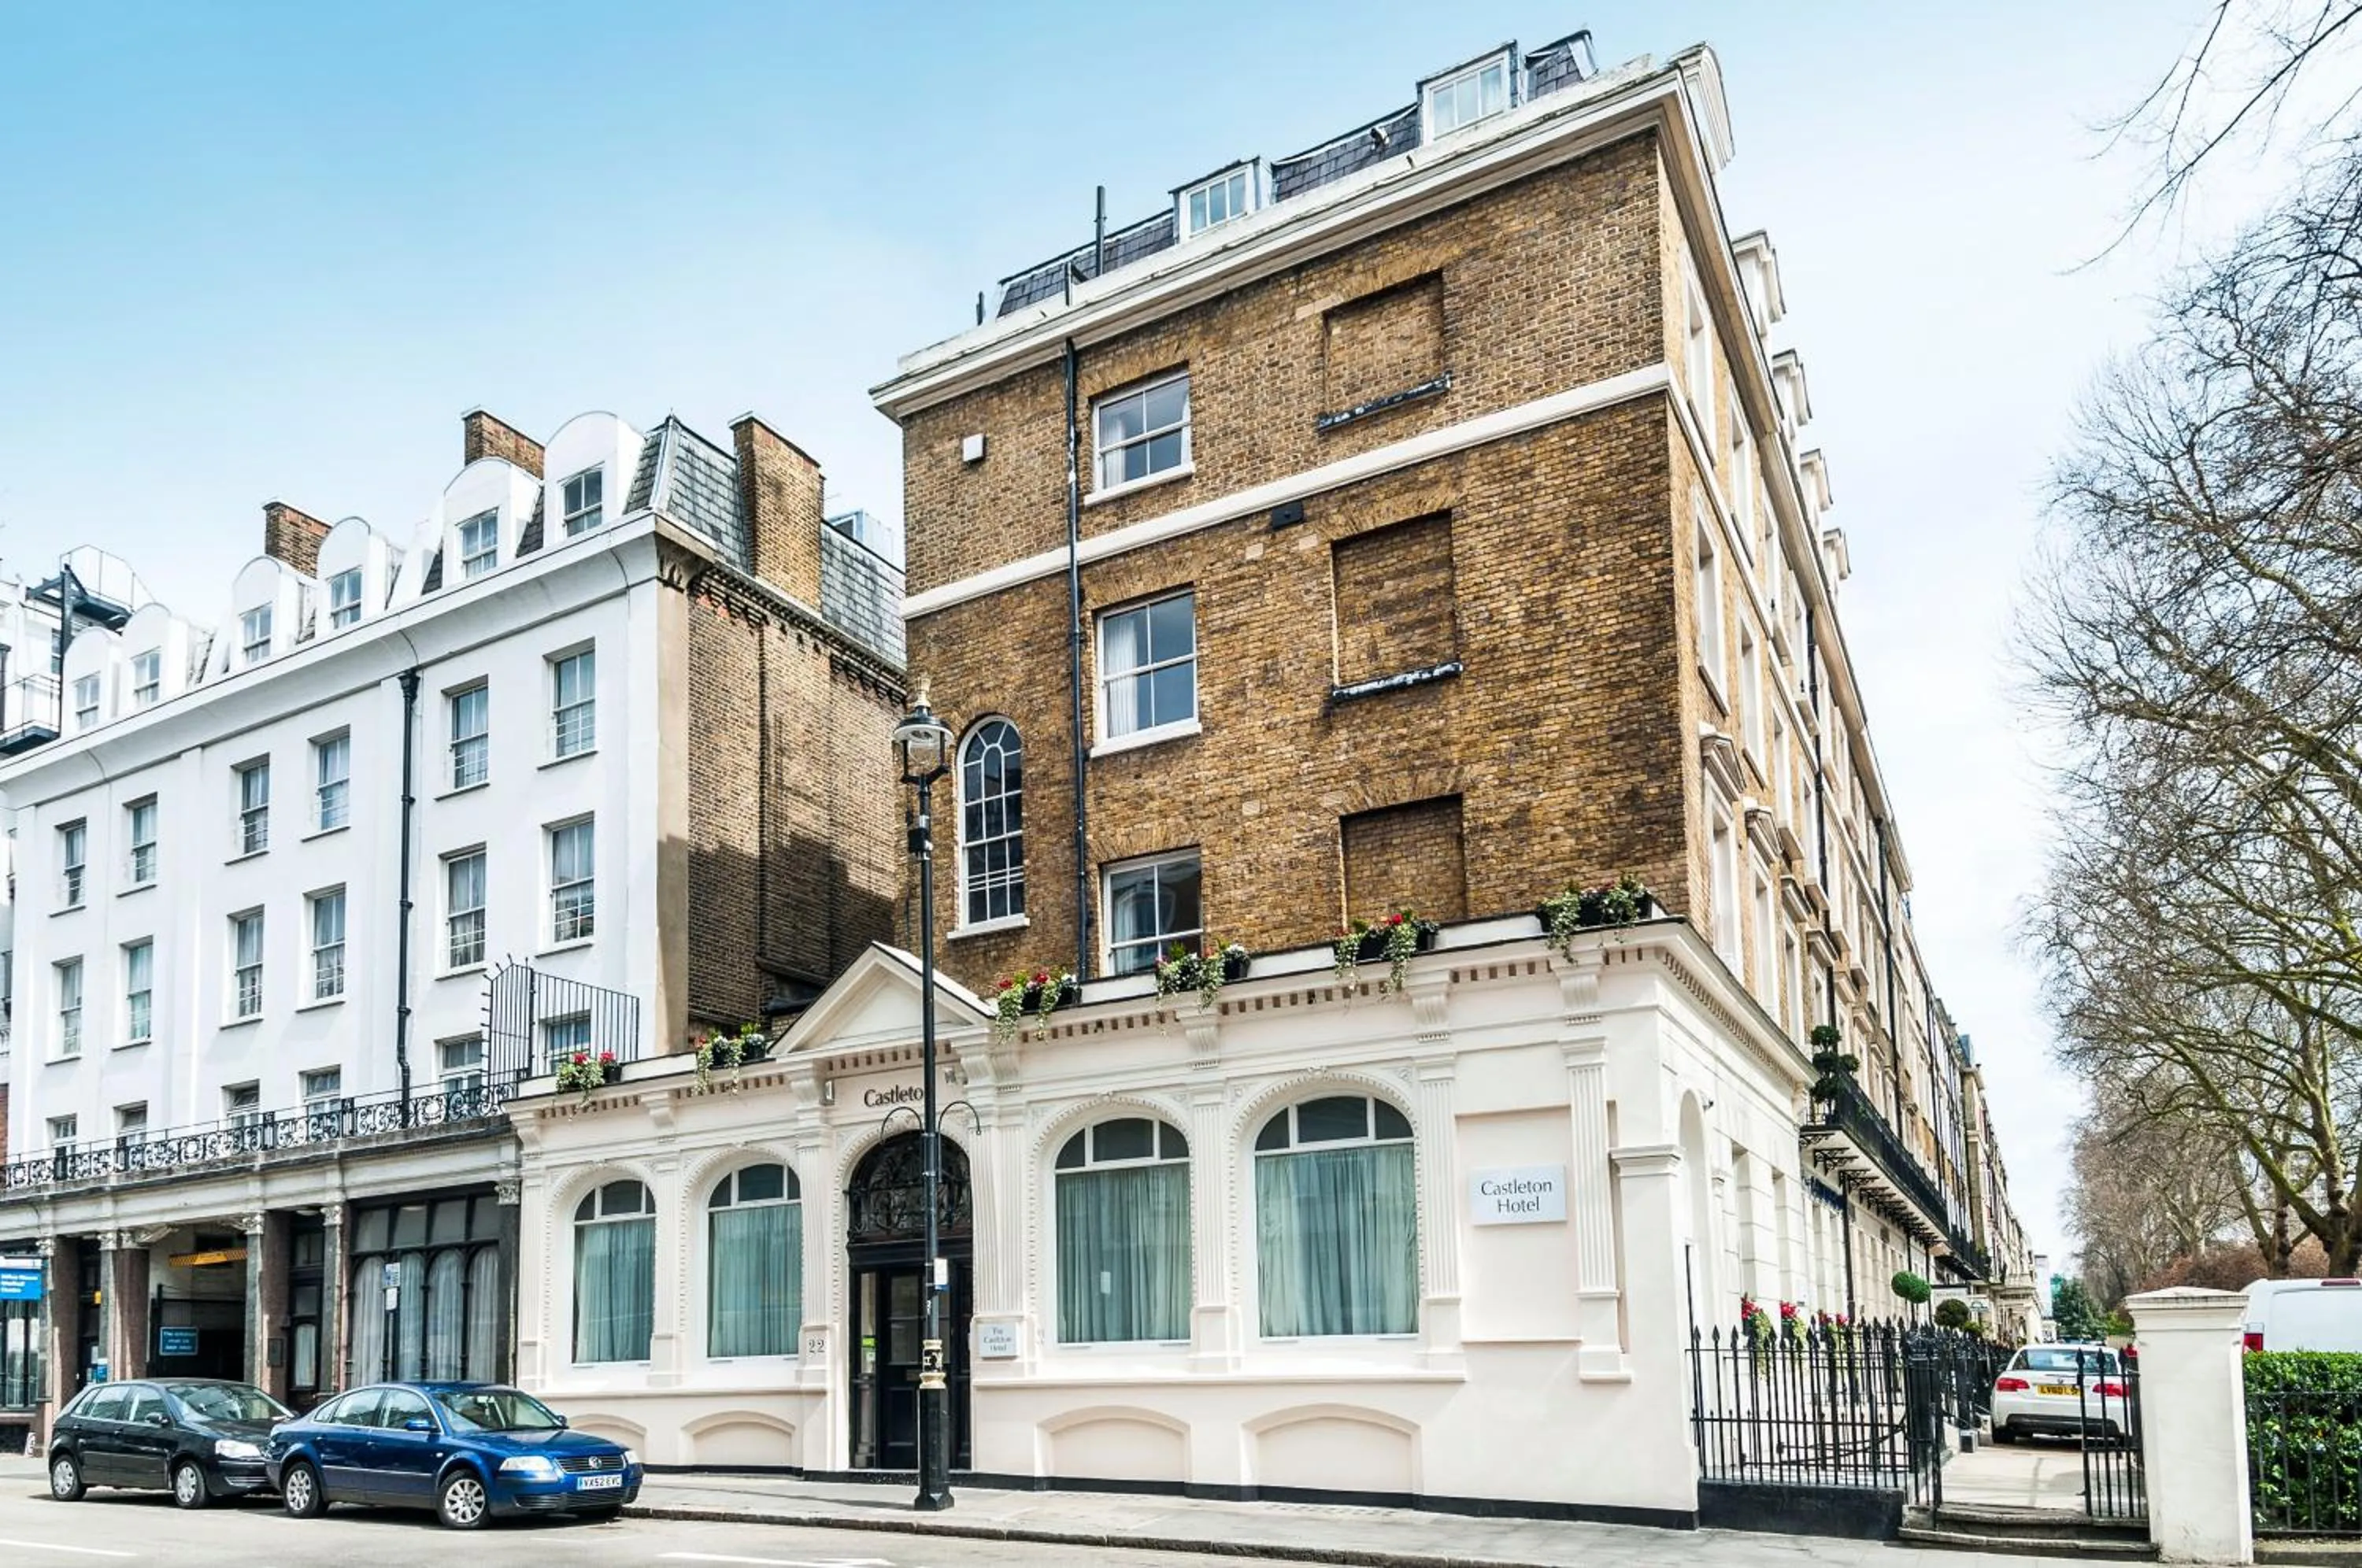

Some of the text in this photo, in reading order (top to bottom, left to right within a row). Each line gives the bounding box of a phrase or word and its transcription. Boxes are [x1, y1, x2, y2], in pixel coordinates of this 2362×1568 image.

[864, 1084, 924, 1107] Castleto
[1481, 1178, 1552, 1196] Castleton
[1498, 1196, 1539, 1213] Hotel
[809, 1339, 825, 1353] 22
